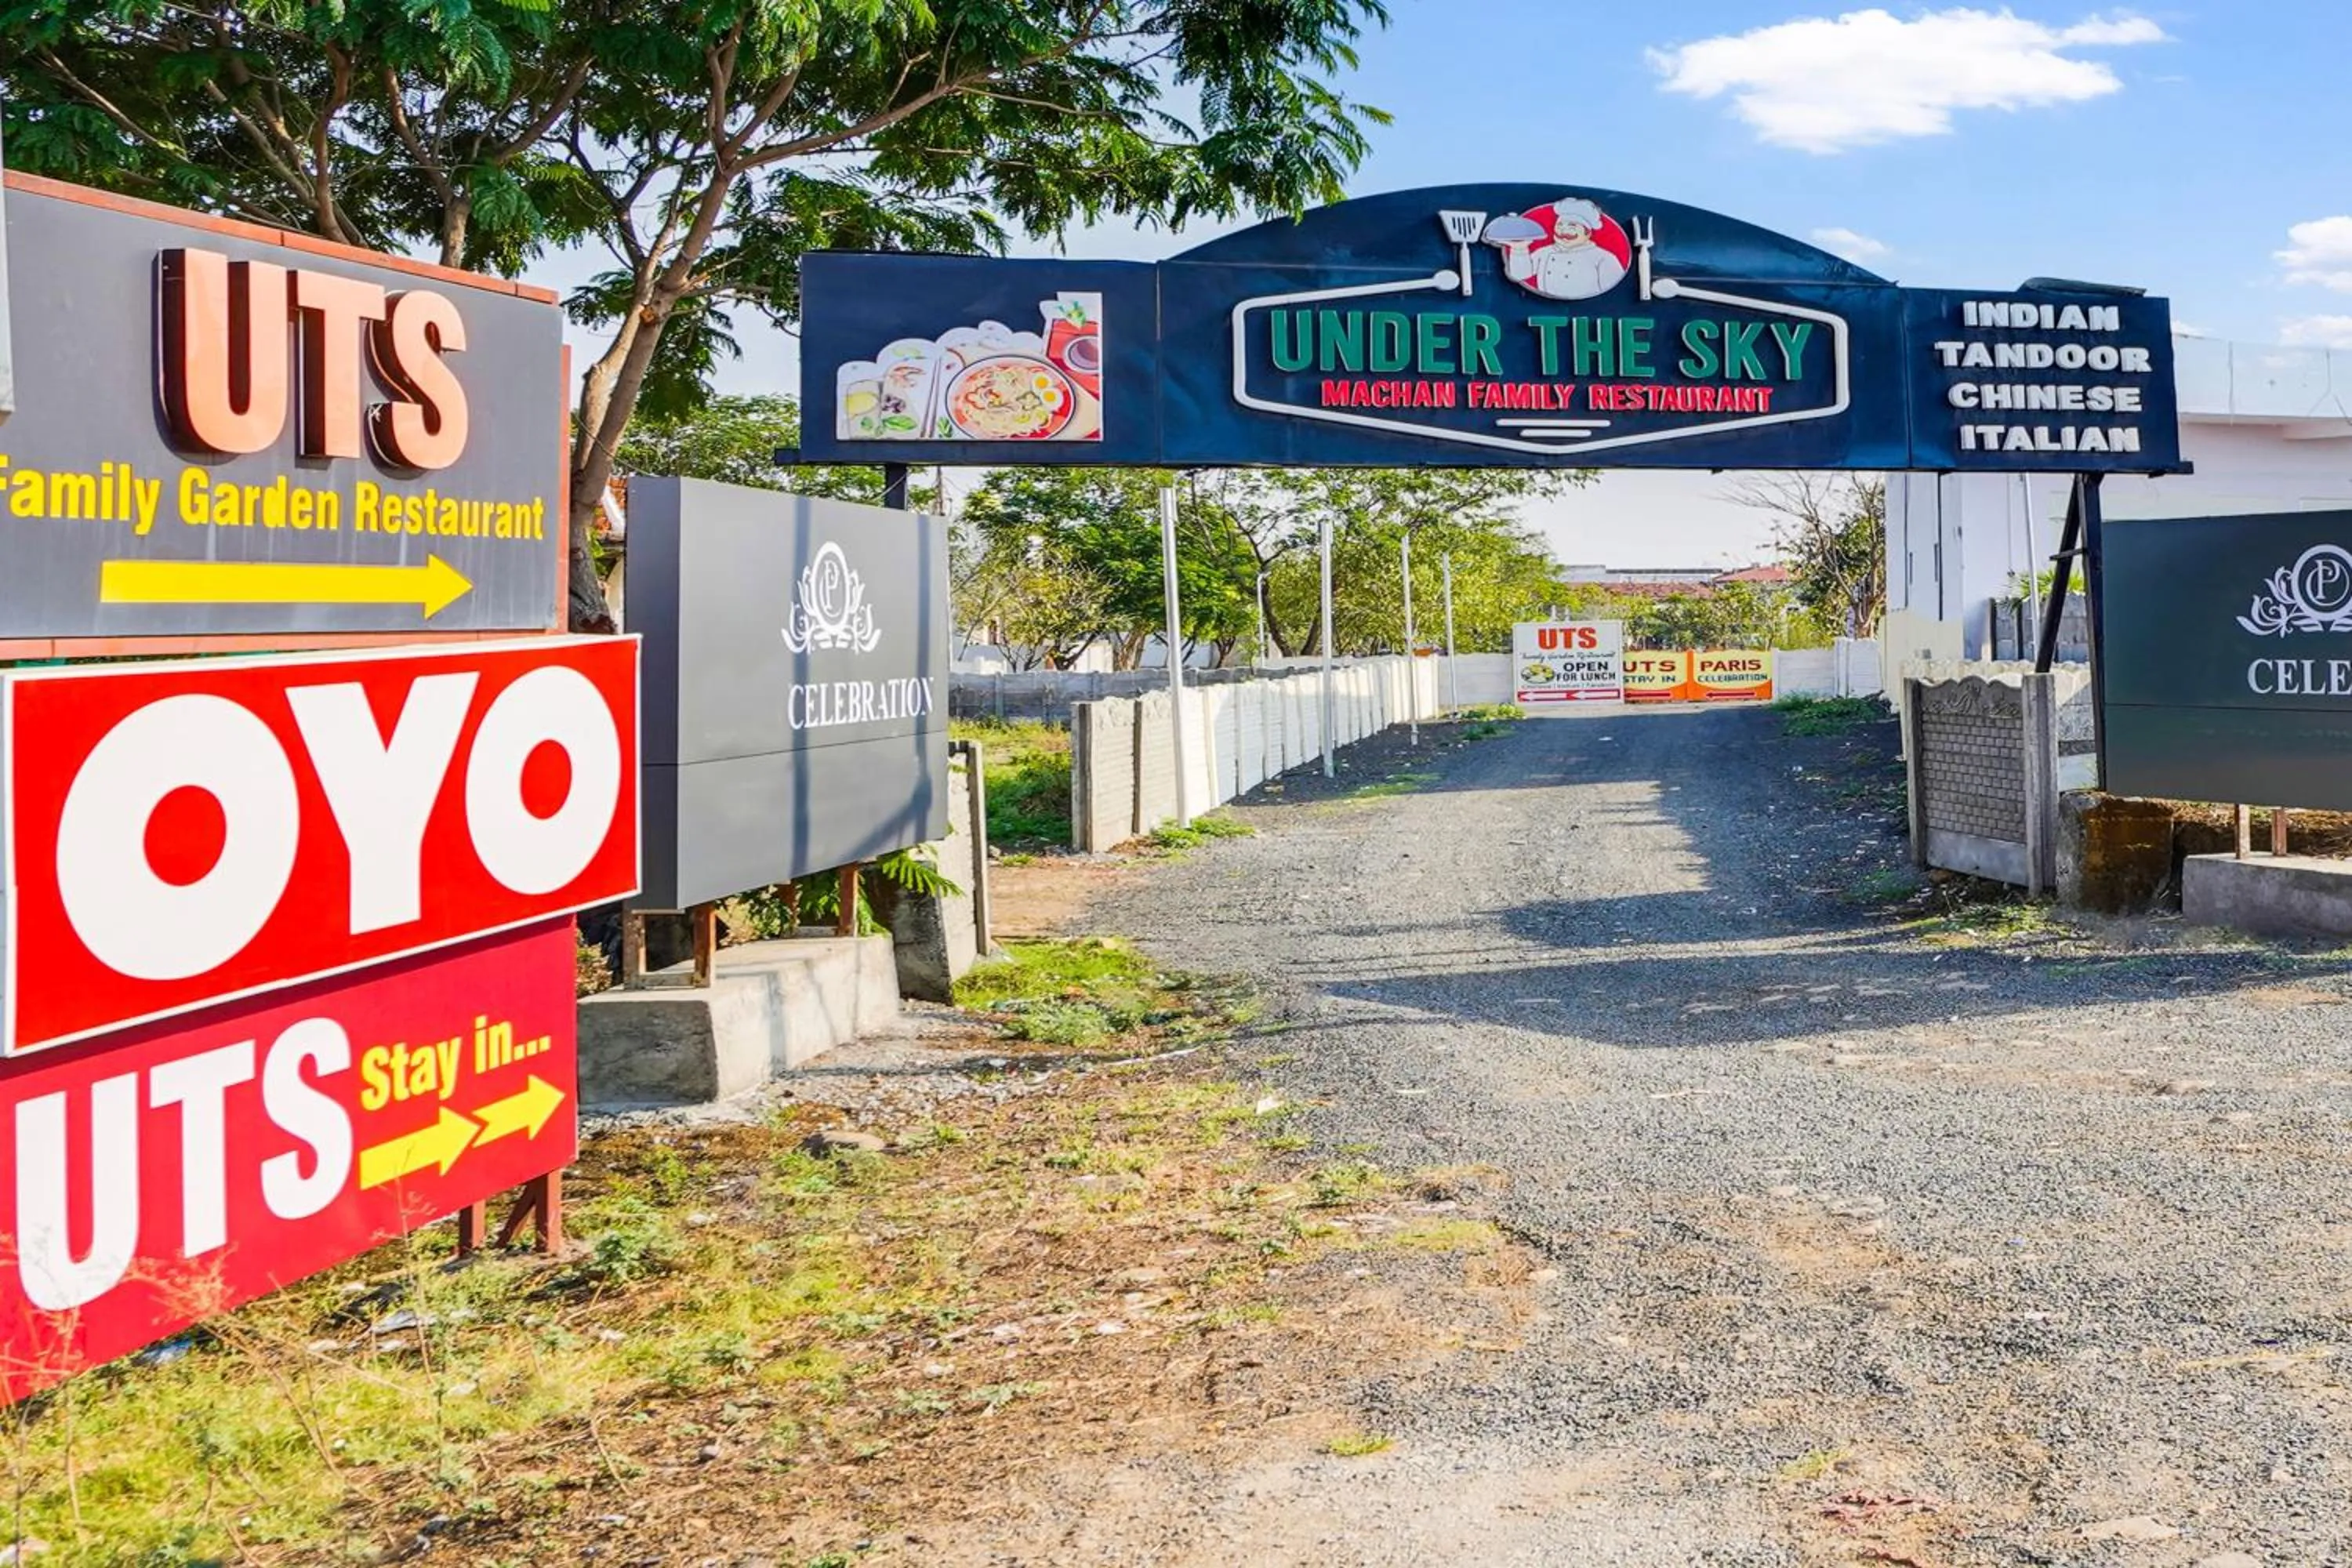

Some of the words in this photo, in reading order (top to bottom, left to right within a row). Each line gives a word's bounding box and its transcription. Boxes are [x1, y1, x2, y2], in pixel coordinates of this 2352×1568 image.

[1962, 301, 2120, 331] INDIAN
[159, 247, 469, 470] UTS
[1270, 310, 1503, 376] UNDER
[1528, 316, 1655, 378] THE
[1679, 319, 1813, 381] SKY
[1934, 341, 2152, 372] TANDOOR
[1320, 379, 1456, 408] MACHAN
[1467, 382, 1577, 410] FAMILY
[1588, 384, 1774, 414] RESTAURANT
[1948, 383, 2143, 412] CHINESE
[1961, 425, 2141, 452] ITALIAN
[179, 466, 339, 530] Garden
[355, 481, 544, 540] Restaurant
[1538, 627, 1597, 649] UTS
[1556, 672, 1577, 681] FOR
[1581, 672, 1616, 681] LUNCH
[1563, 662, 1609, 671] OPEN
[1623, 659, 1676, 672] UTS
[1697, 673, 1768, 683] CELEBRATION
[1700, 659, 1761, 672] PARIS
[787, 677, 934, 729] CELEBRATION
[56, 665, 622, 981] OYO
[16, 1017, 353, 1311] UTS
[361, 1037, 461, 1112] Stay
